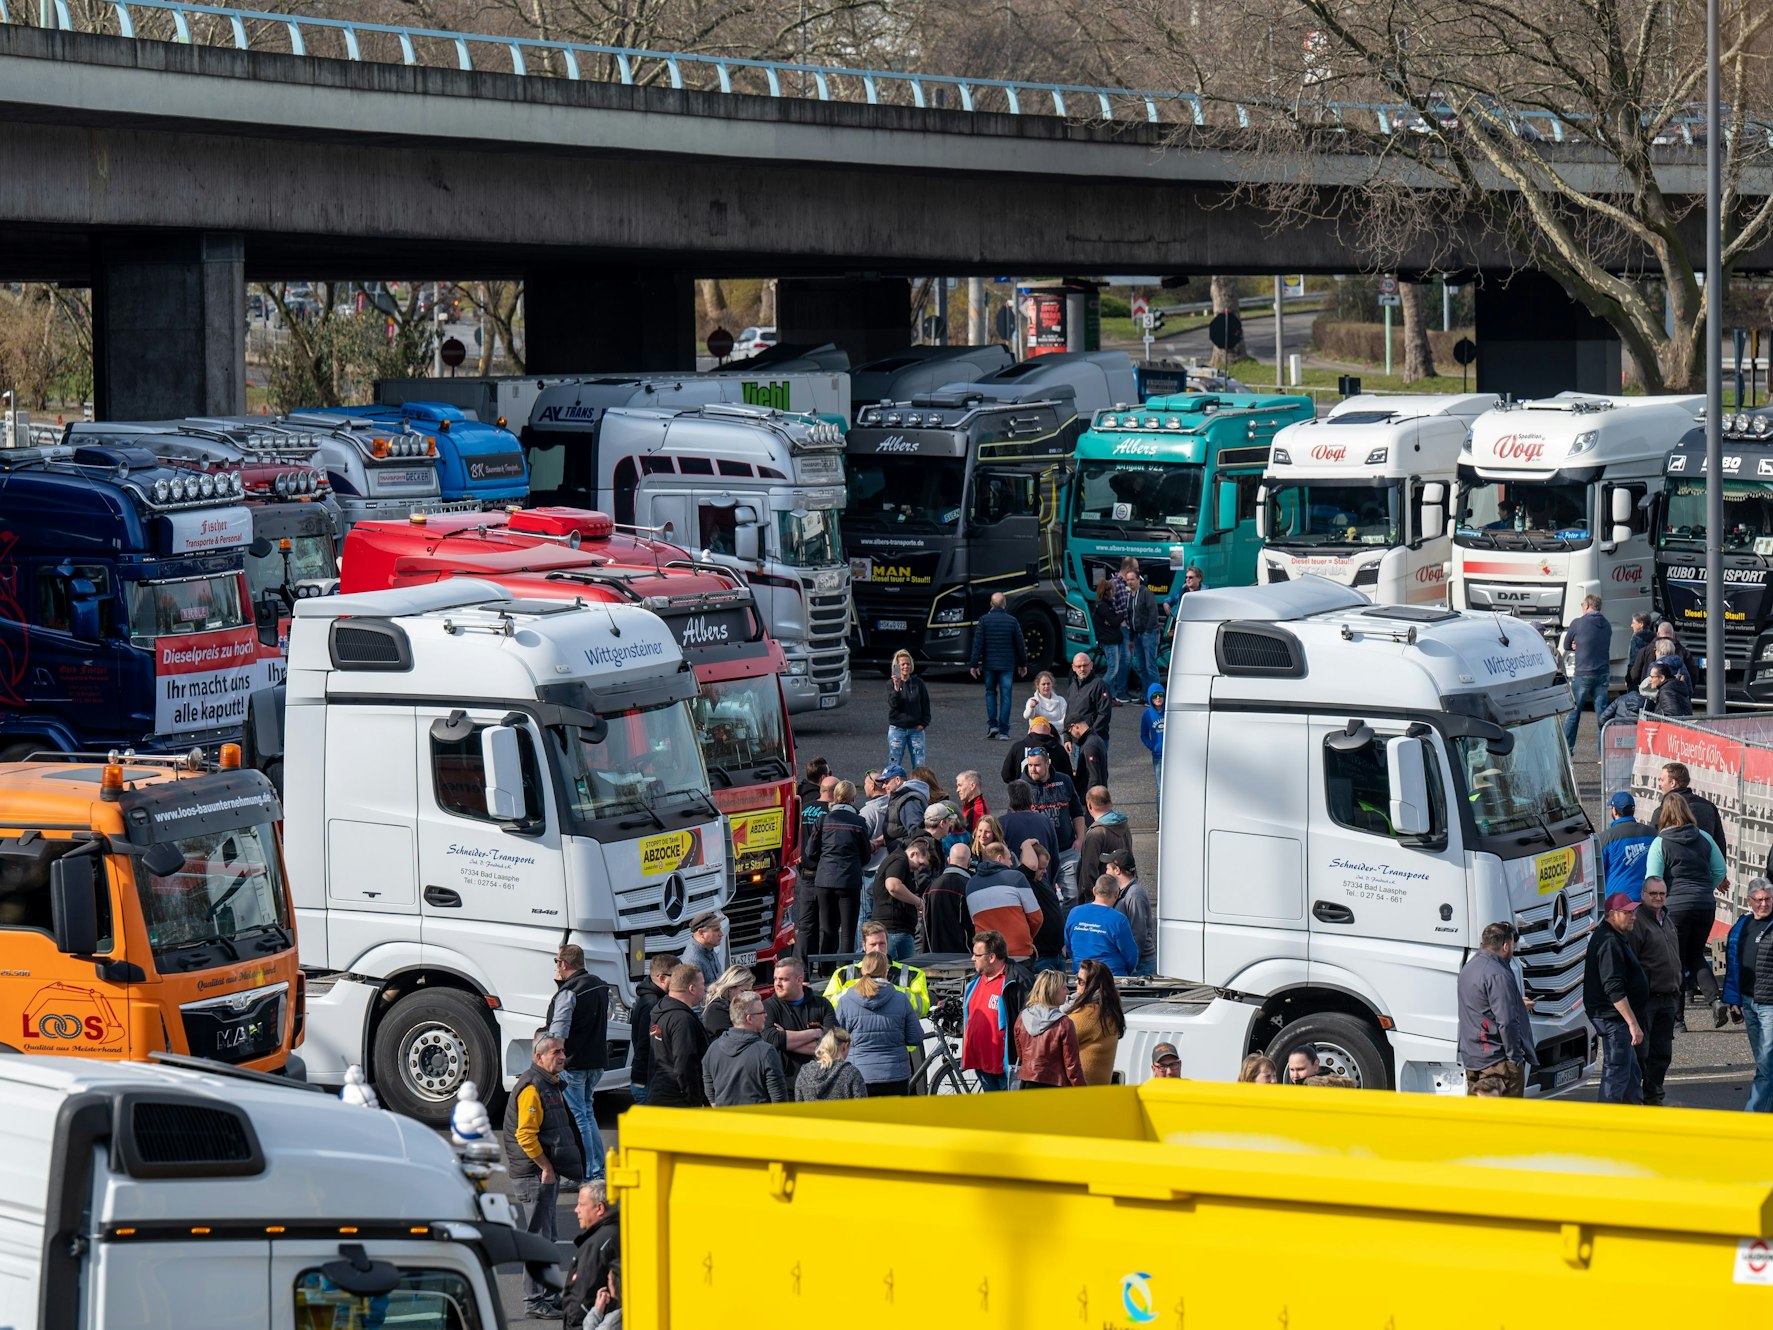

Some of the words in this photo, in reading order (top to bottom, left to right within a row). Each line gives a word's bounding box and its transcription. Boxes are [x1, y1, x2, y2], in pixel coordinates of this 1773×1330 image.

[1145, 315, 1151, 326] 3
[565, 406, 594, 419] TRANS
[876, 435, 919, 452] Albers
[1113, 438, 1158, 455] Albers
[1493, 434, 1545, 462] Vogt
[1311, 444, 1347, 462] Vogt
[405, 472, 429, 481] DECKER
[471, 463, 485, 478] BK
[201, 520, 227, 535] Fischer
[186, 538, 214, 548] Transporte
[220, 533, 242, 544] Personal
[861, 539, 924, 547] www.albers-transporte.de
[1096, 545, 1162, 553] www.albers-transporte.de
[873, 566, 911, 577] MAN
[1416, 563, 1444, 583] Vogt
[1612, 564, 1642, 583] Vogt
[1667, 566, 1696, 579] KUBO
[1698, 568, 1766, 582] TSPORT
[1497, 592, 1530, 601] DAF
[1685, 609, 1702, 618] Diesel
[1725, 611, 1745, 620] Stau!!!
[683, 615, 728, 646] Albers
[163, 644, 219, 665] Dieselpreis
[221, 647, 232, 659] zu
[234, 639, 254, 656] hoch
[584, 640, 664, 667] Wittgensteiner
[268, 662, 287, 682] Ihr
[1483, 649, 1545, 678] Wittgensteiner
[167, 680, 186, 699] Ihr
[189, 674, 227, 697] macht
[230, 674, 250, 690] uns
[174, 701, 198, 723] alle
[201, 696, 244, 723] kaputt!
[1667, 734, 1679, 754] Wir
[1680, 736, 1698, 759] bauen
[1698, 740, 1706, 761] für
[1706, 743, 1721, 764] Köln
[155, 792, 271, 822] www.loos-bauunternehmung.de
[646, 840, 661, 849] STOPPT
[446, 844, 535, 865] Schneider-Transporte
[460, 868, 479, 876] 57334
[494, 872, 520, 882] Laasphe
[1329, 858, 1430, 881] Schneider-Transporte
[1343, 880, 1363, 889] 57334
[1364, 883, 1377, 892] Bad
[1379, 886, 1407, 896] Laasphe
[198, 978, 224, 991] Qualität
[22, 1014, 104, 1040] LOOS
[217, 1022, 263, 1050] MAN
[72, 1045, 123, 1053] Meisterhand
